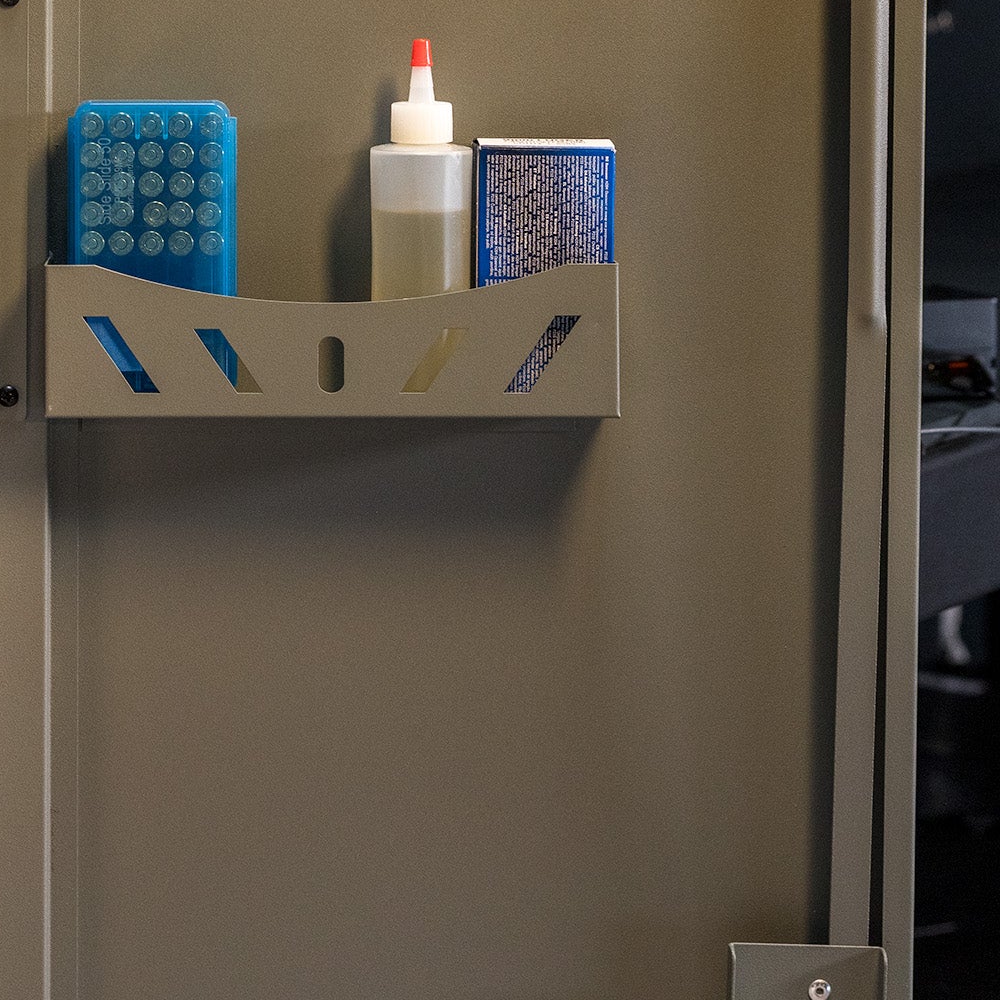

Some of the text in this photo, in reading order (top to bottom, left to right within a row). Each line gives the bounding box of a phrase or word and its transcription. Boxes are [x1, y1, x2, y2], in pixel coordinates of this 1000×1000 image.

[97, 137, 112, 225] Side Slide 50
